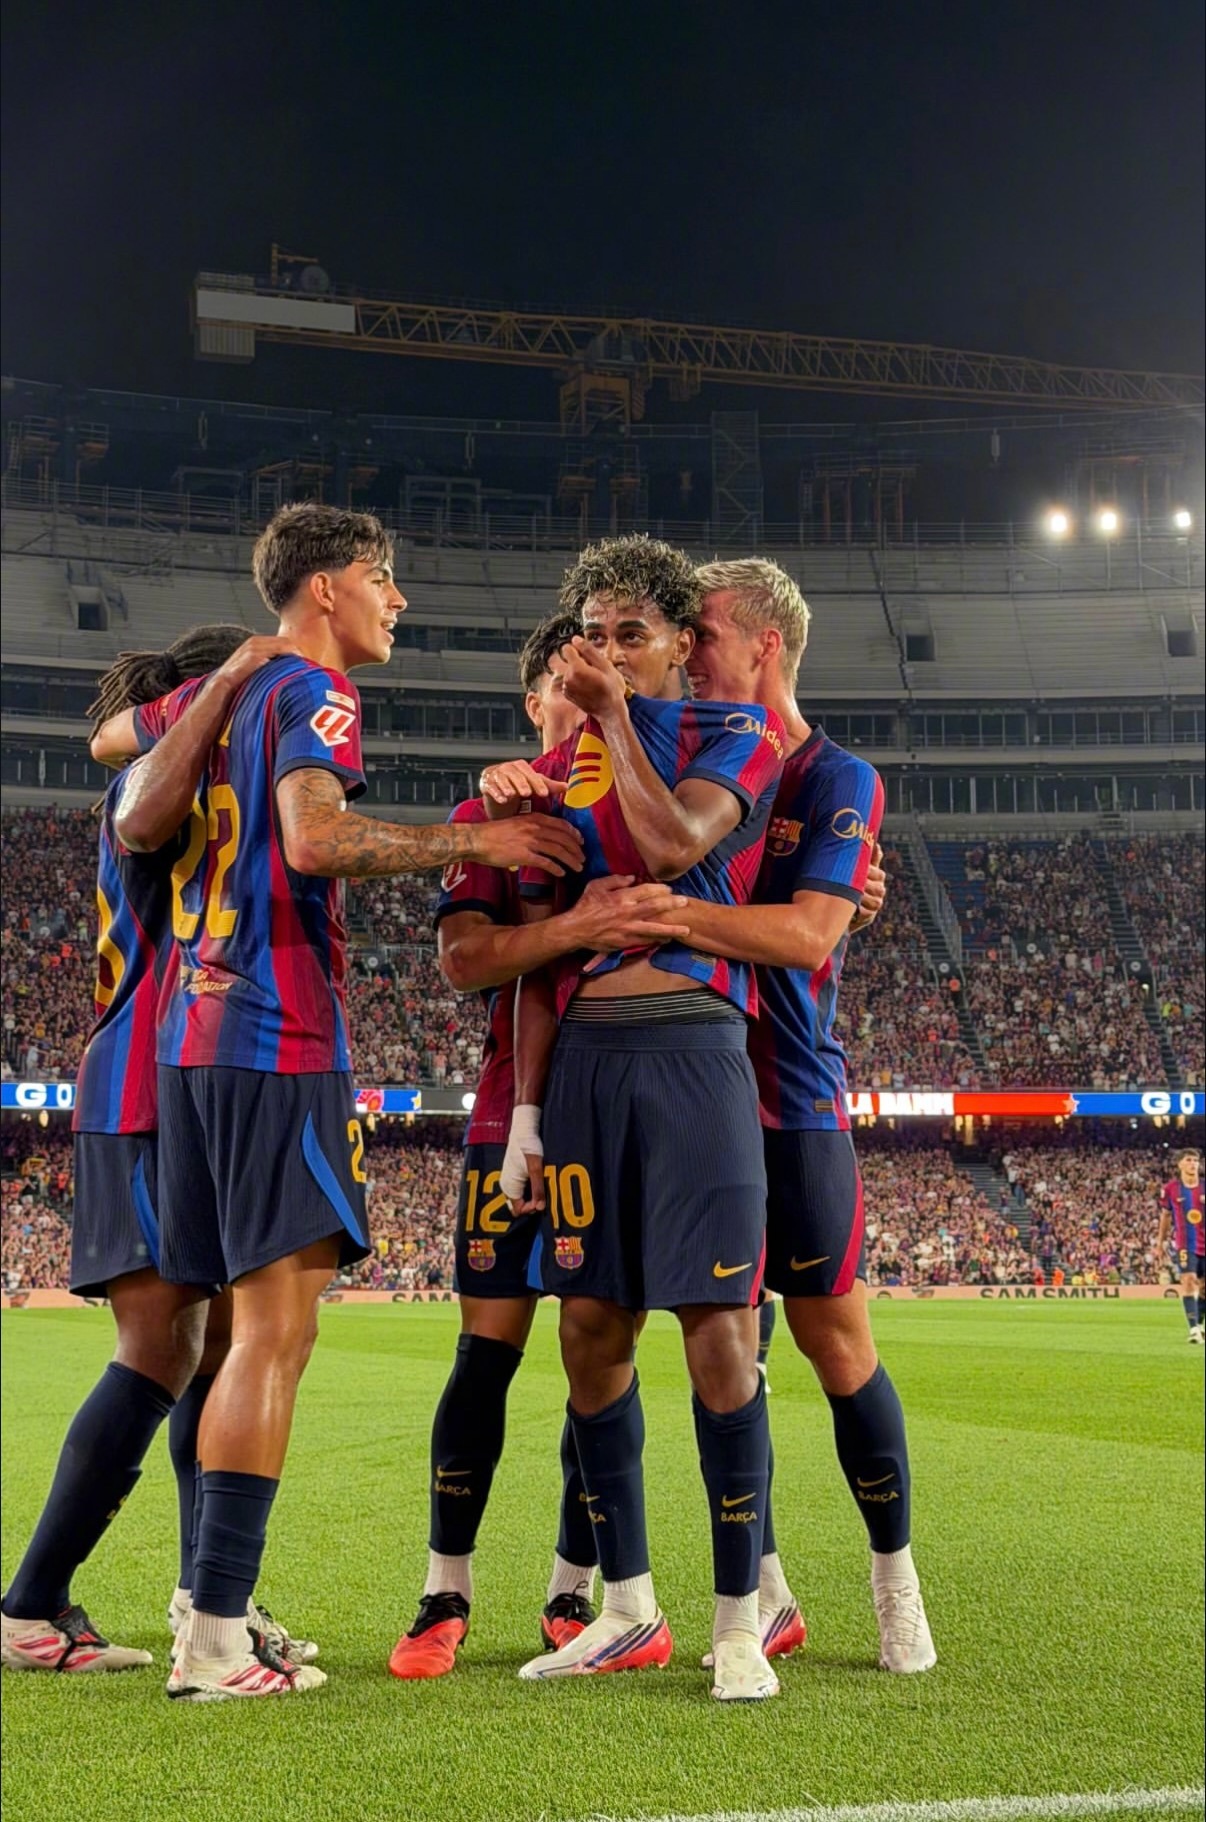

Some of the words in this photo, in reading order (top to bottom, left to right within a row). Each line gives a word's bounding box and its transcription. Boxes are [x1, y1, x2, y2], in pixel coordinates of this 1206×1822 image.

[725, 713, 784, 760] Midea
[171, 784, 240, 939] 22
[466, 1170, 511, 1232] 12
[544, 1164, 594, 1228] 10
[391, 1293, 452, 1303] SAM
[980, 1287, 1037, 1299] SAM
[1042, 1287, 1120, 1299] SMITH
[720, 1512, 758, 1524] BARÇA
